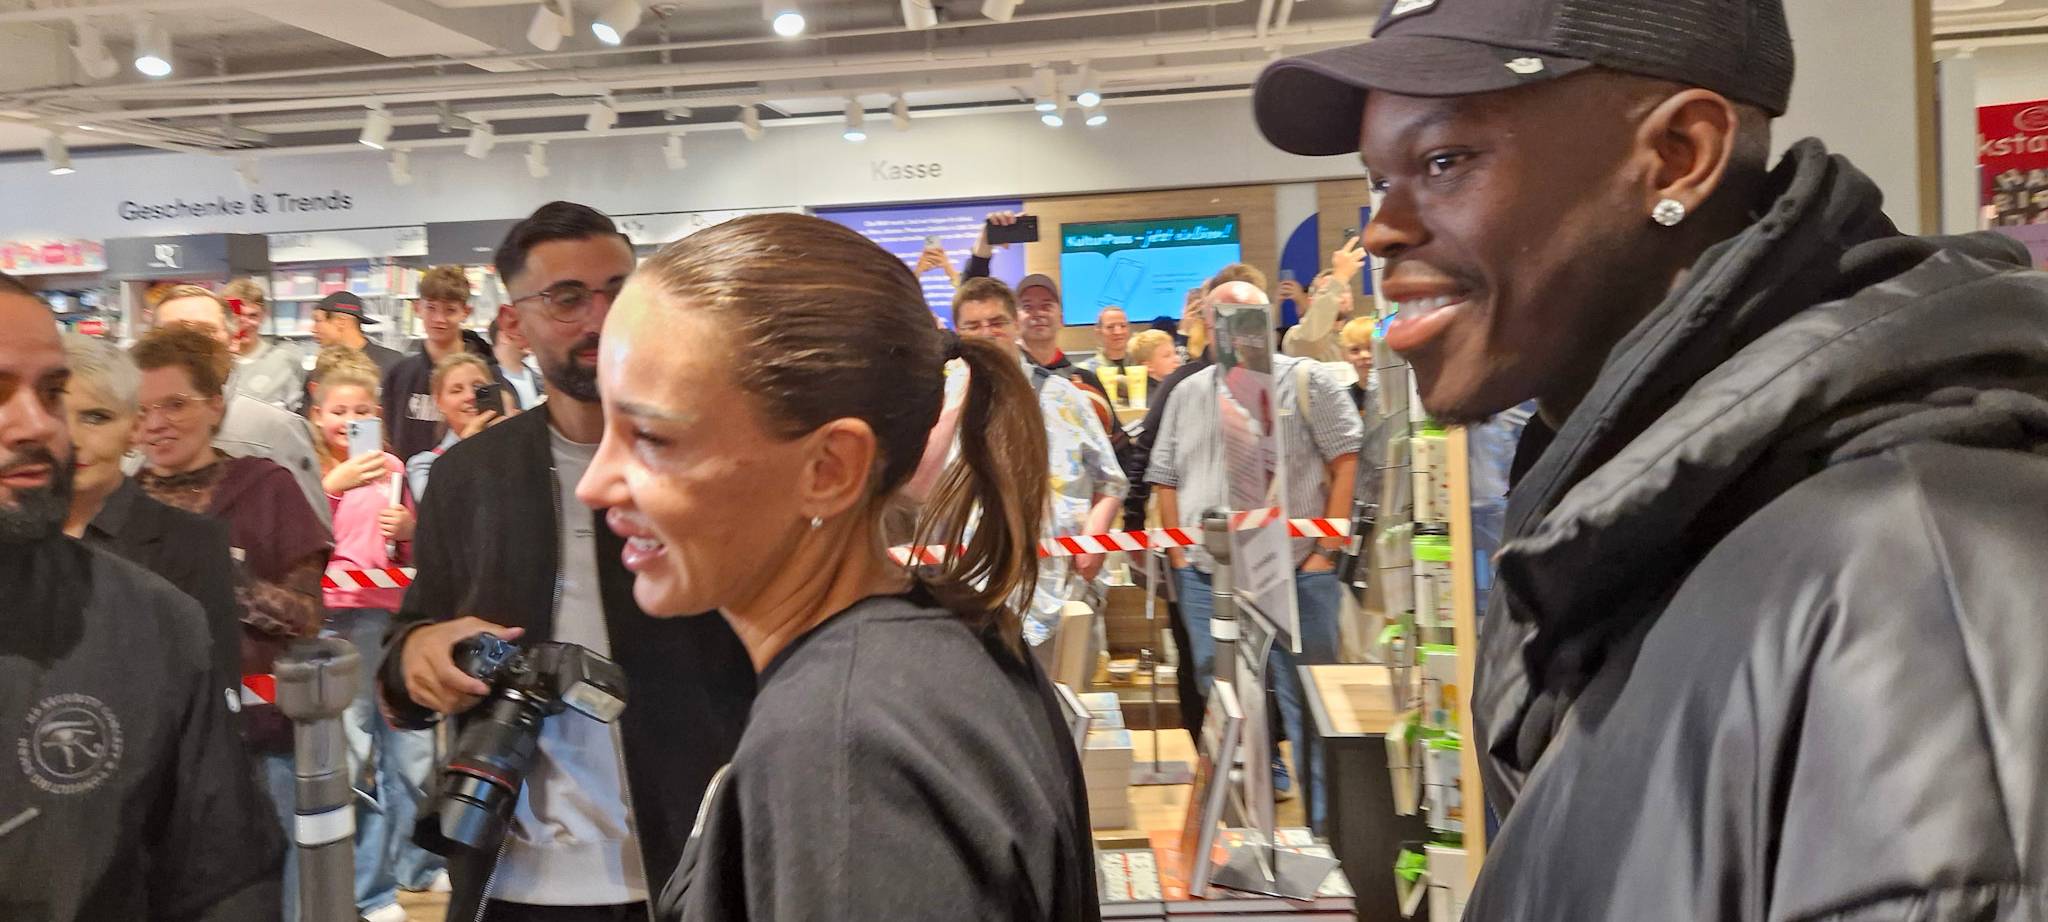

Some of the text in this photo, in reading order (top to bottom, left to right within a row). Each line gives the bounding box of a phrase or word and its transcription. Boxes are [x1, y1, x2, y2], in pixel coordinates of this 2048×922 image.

[870, 160, 943, 181] Kasse
[118, 189, 353, 221] Geschenke & Trends
